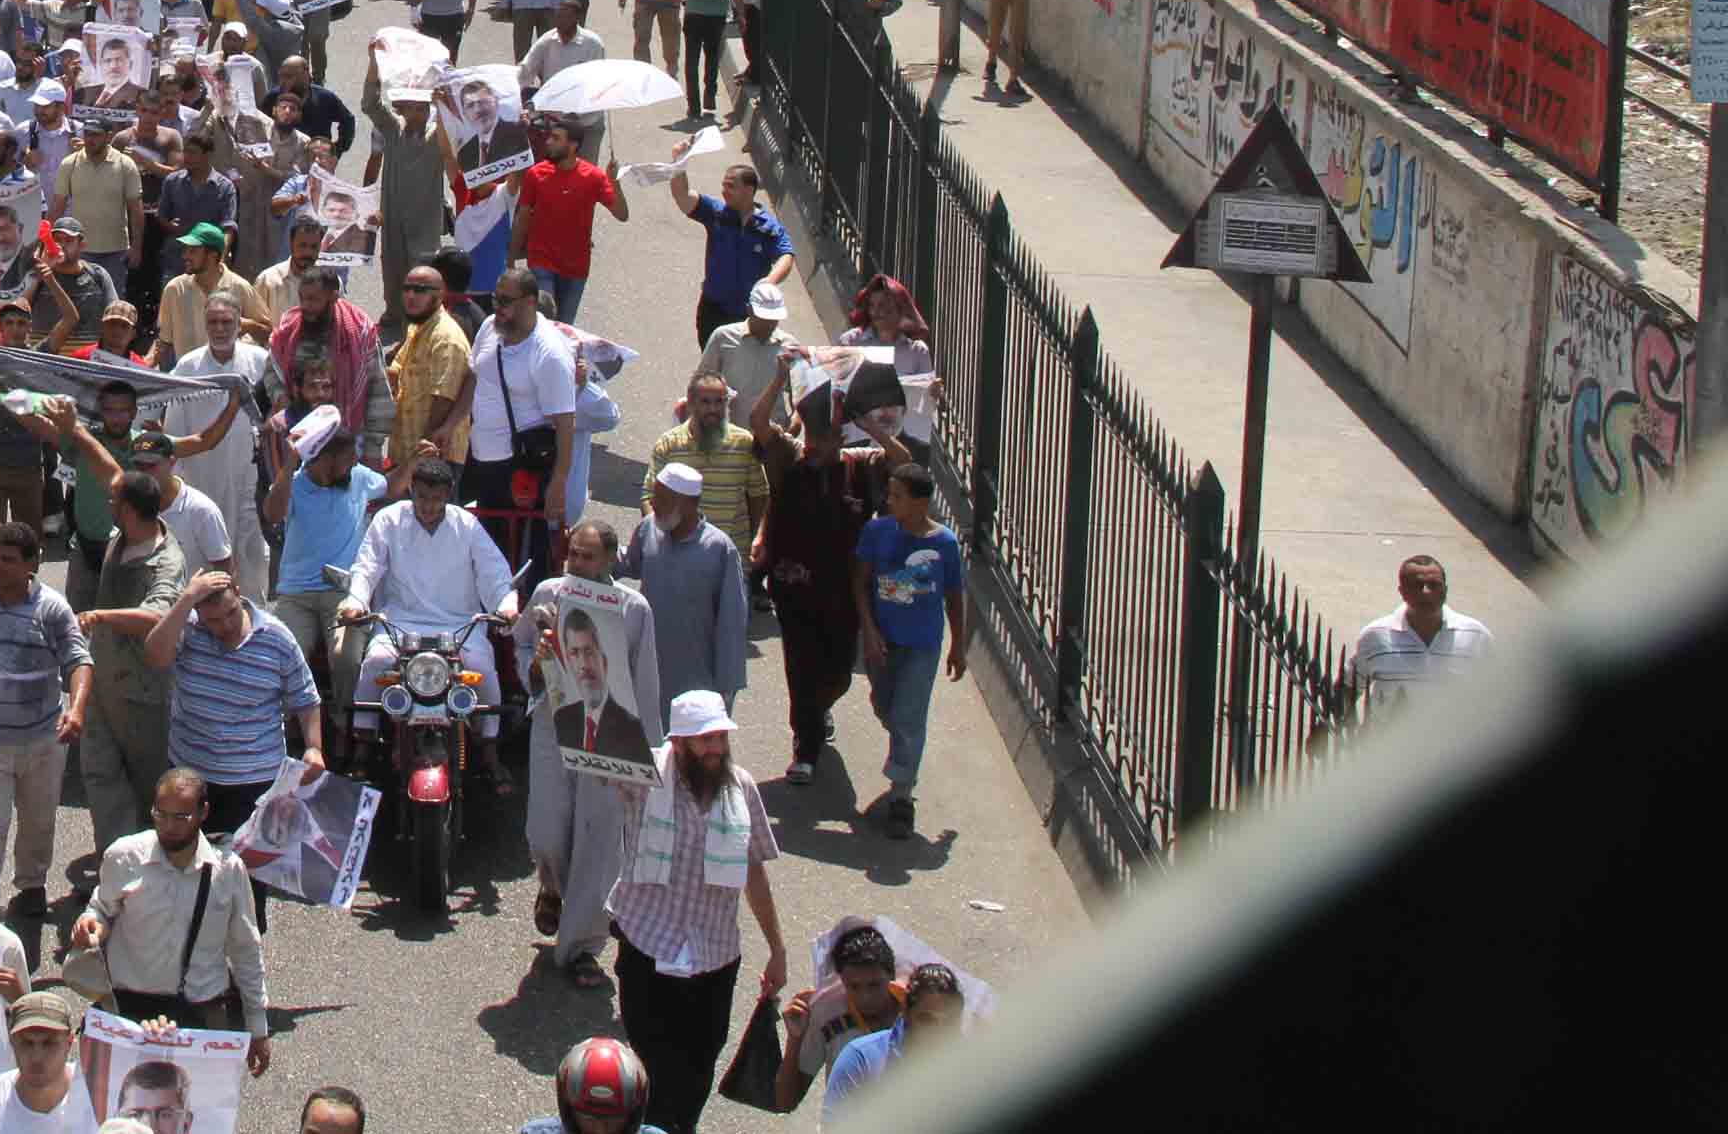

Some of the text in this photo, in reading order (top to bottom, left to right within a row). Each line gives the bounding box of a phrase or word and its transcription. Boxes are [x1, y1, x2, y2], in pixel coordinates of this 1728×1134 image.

[563, 753, 654, 780] لا للانقلاب
[202, 1036, 245, 1054] نعم
